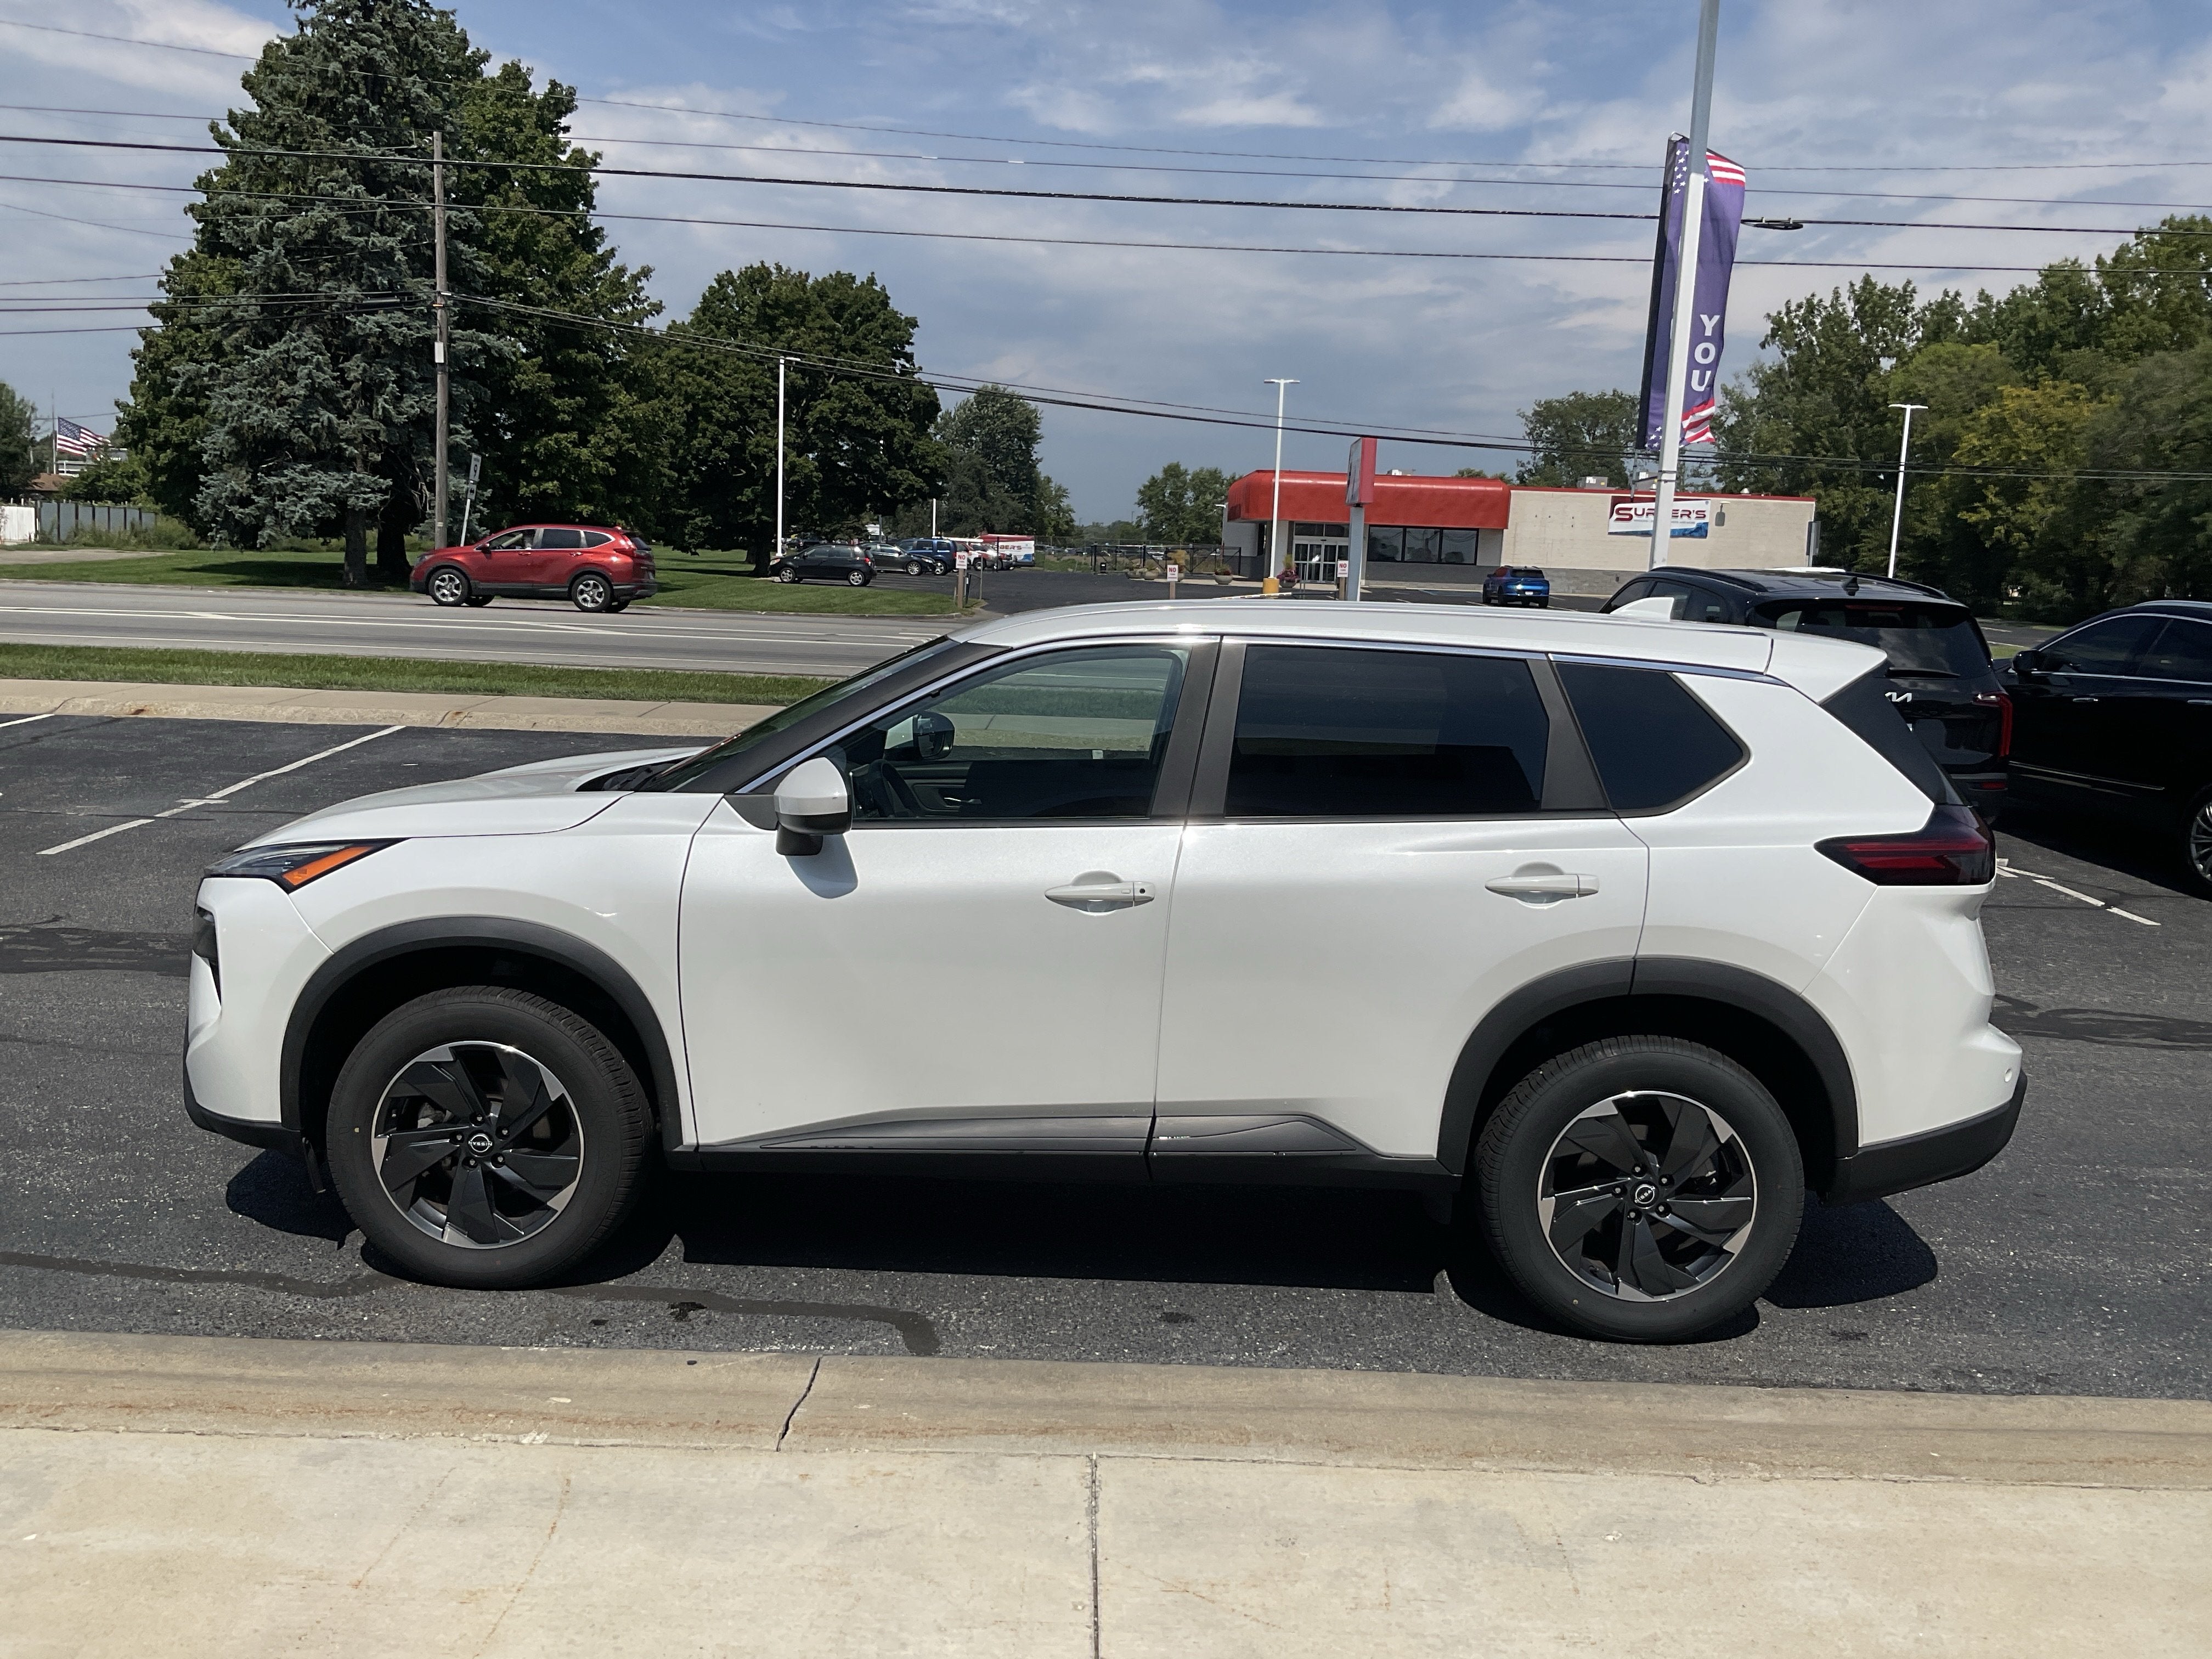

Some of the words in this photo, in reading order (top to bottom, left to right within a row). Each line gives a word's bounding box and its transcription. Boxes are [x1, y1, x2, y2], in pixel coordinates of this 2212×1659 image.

[1691, 314, 1720, 392] YOU
[473, 464, 478, 478] 9
[1615, 507, 1706, 522] SURER'S
[1634, 1186, 1656, 1204] NISSAN
